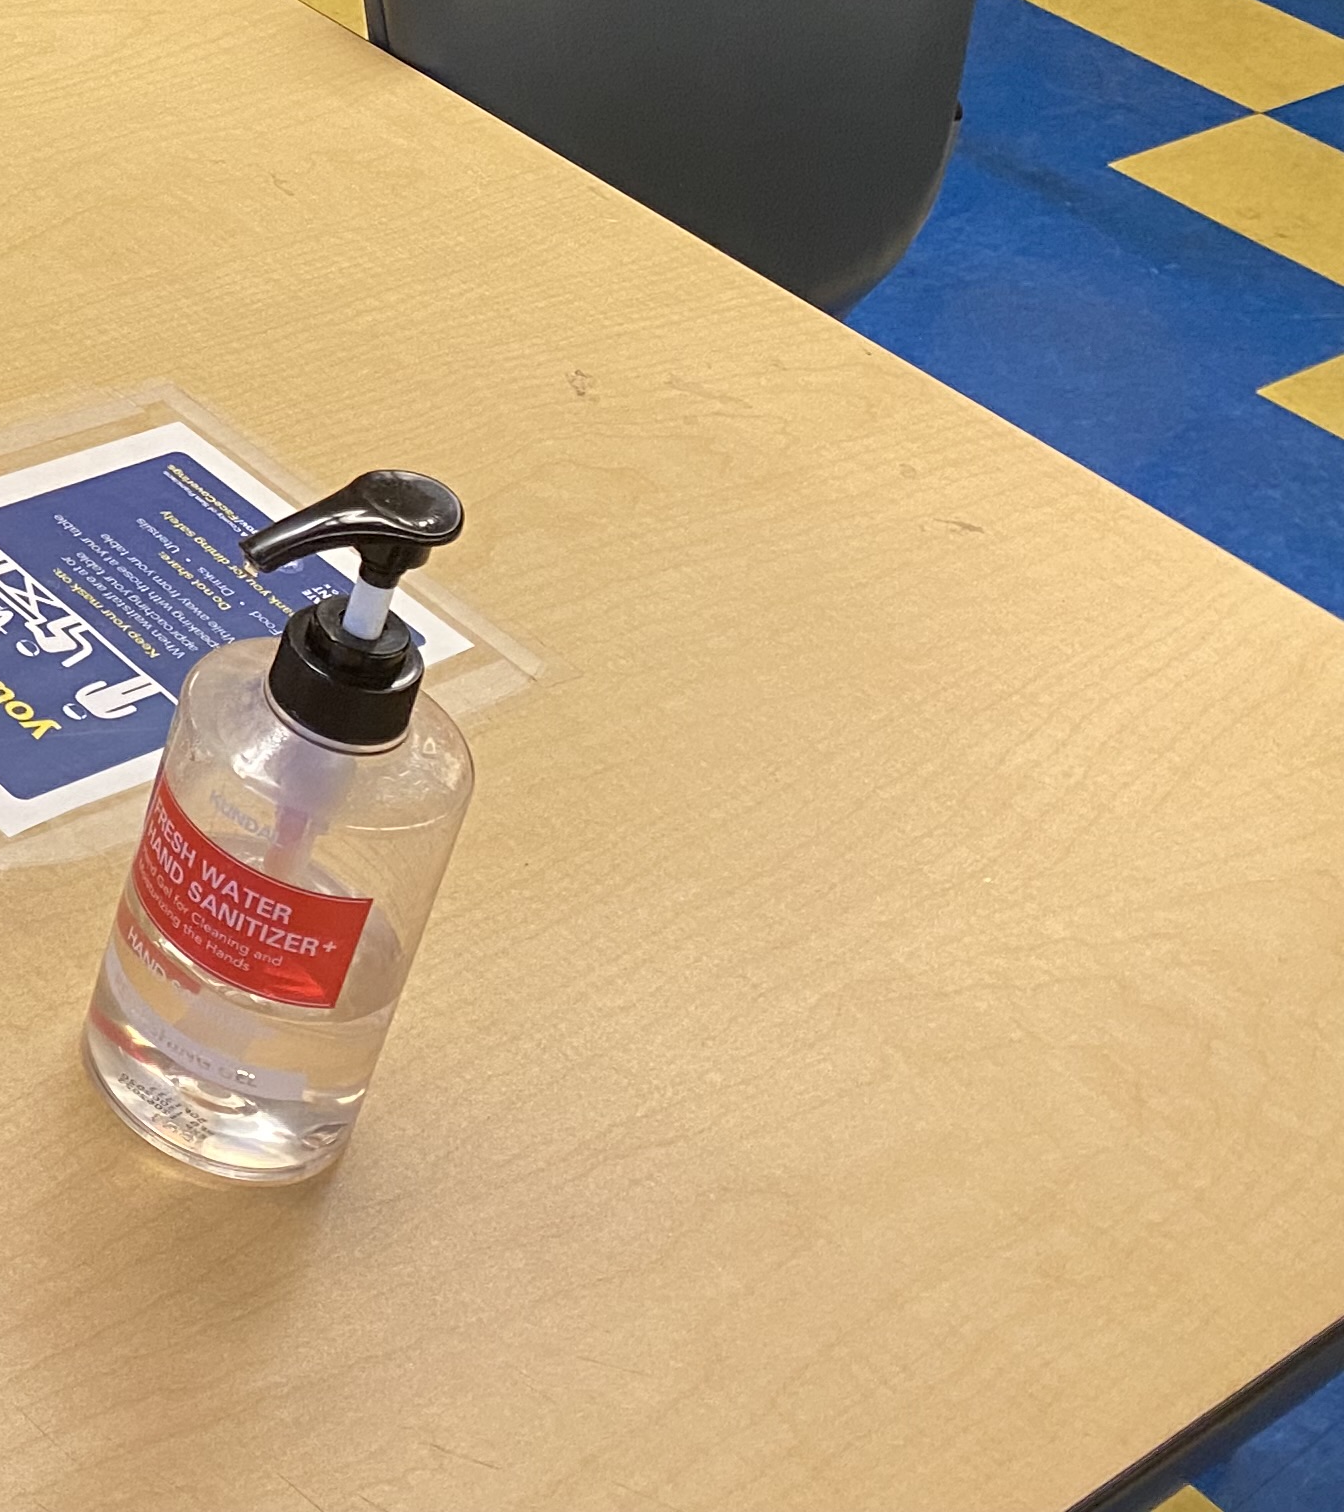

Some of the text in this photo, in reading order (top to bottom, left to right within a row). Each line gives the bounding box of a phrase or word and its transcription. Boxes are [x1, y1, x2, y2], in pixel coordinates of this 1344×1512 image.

[53, 513, 82, 537] table
[79, 536, 109, 557] your
[99, 532, 130, 556] table
[102, 555, 119, 566] at
[125, 555, 157, 577] your
[159, 510, 295, 617] ank you for dining safely
[115, 565, 150, 592] those
[135, 517, 284, 636] Food Drinks Utensils
[151, 574, 181, 598] from
[158, 551, 232, 611] Do not share:
[59, 555, 185, 659] When waitstaff are at or
[69, 582, 104, 609] mask
[75, 551, 198, 651] approaching your table
[147, 590, 173, 612] with
[176, 597, 210, 621] away
[99, 608, 132, 632] your
[126, 629, 160, 658] Keep
[147, 818, 184, 885] HAND
[154, 795, 293, 925] FRESH WATER
[157, 874, 173, 899] Gel
[173, 894, 189, 914] for
[191, 912, 250, 957] Cleaning
[253, 951, 284, 967] and
[183, 924, 203, 945] the
[206, 940, 251, 972] Hands
